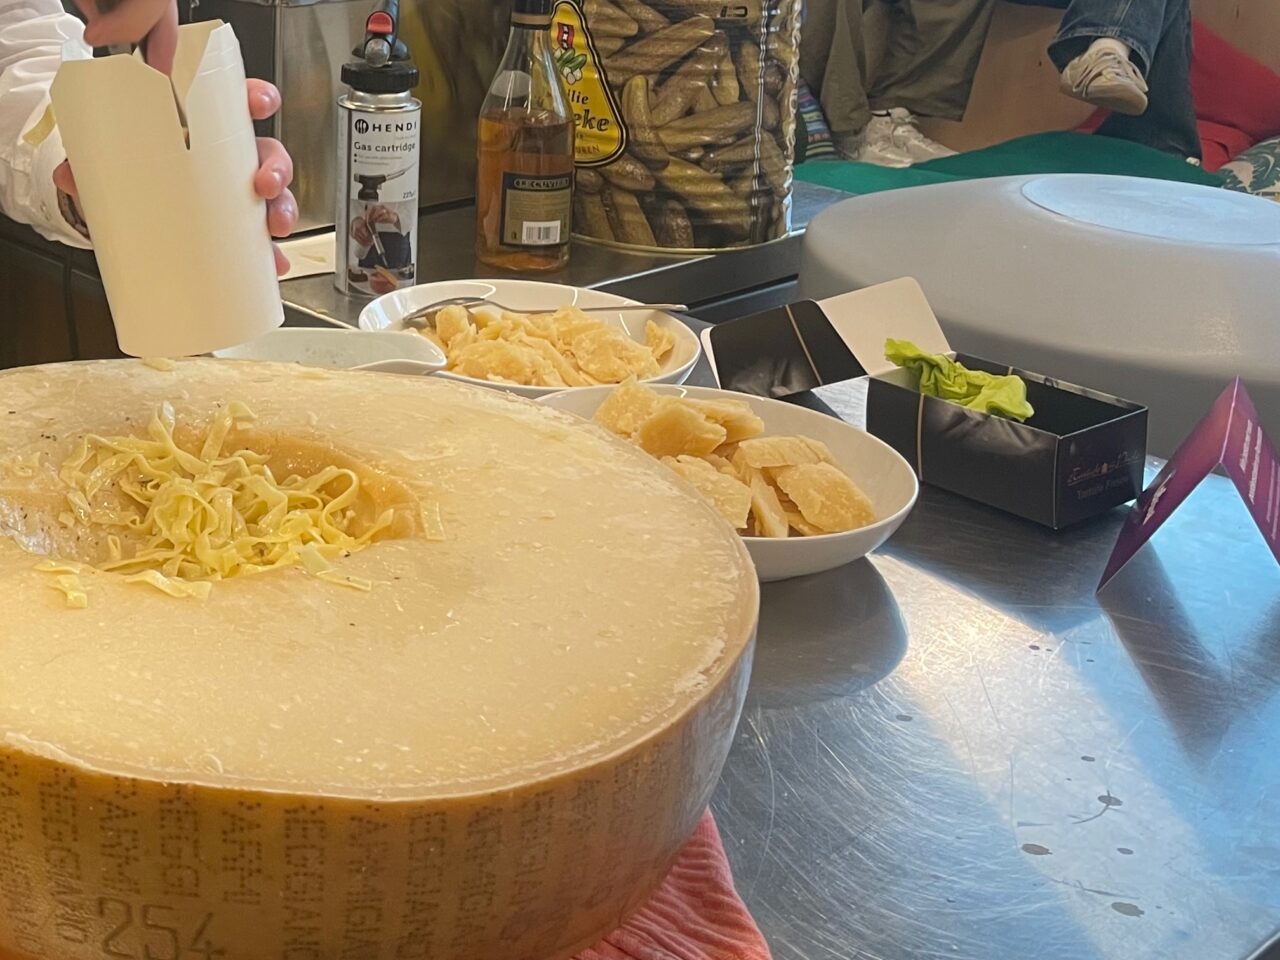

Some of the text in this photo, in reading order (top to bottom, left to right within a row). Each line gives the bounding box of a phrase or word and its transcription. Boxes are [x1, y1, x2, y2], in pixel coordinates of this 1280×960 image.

[372, 122, 417, 132] HENDI
[574, 109, 610, 132] eke
[354, 141, 416, 153] Gas cartridge
[222, 800, 262, 905] ARMI
